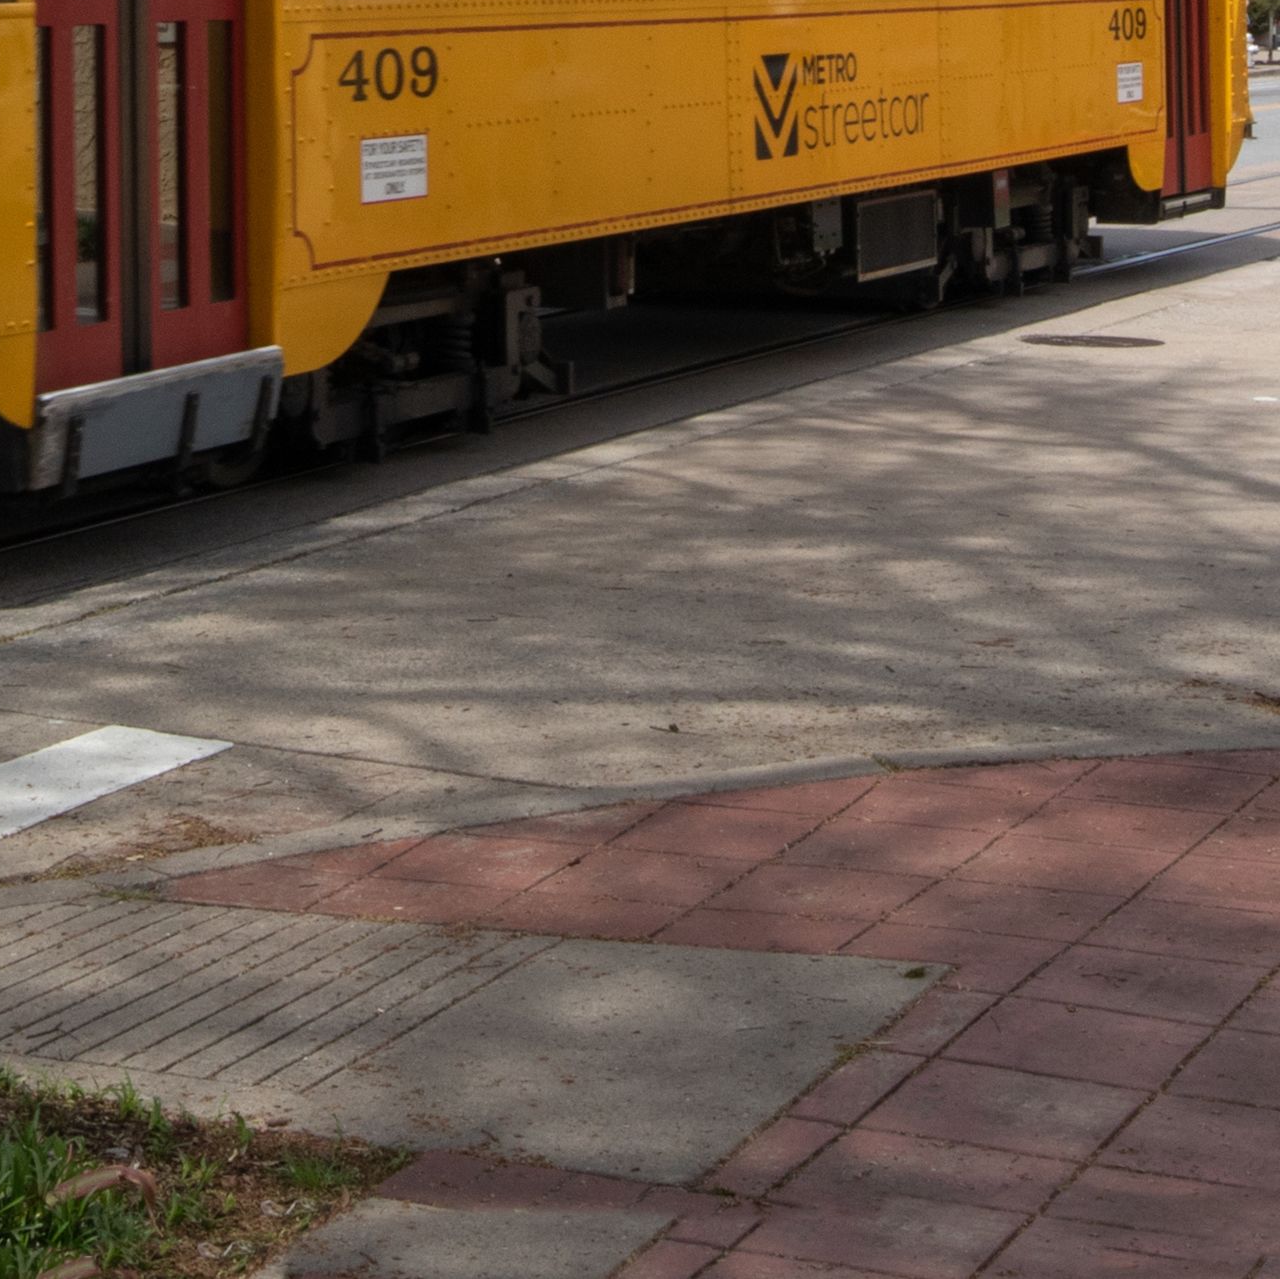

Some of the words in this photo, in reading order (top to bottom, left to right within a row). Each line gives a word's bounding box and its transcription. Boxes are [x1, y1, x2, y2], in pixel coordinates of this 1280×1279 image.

[1108, 7, 1147, 41] 409
[338, 46, 438, 102] 409
[802, 52, 858, 86] METRO
[803, 87, 930, 150] streetcar
